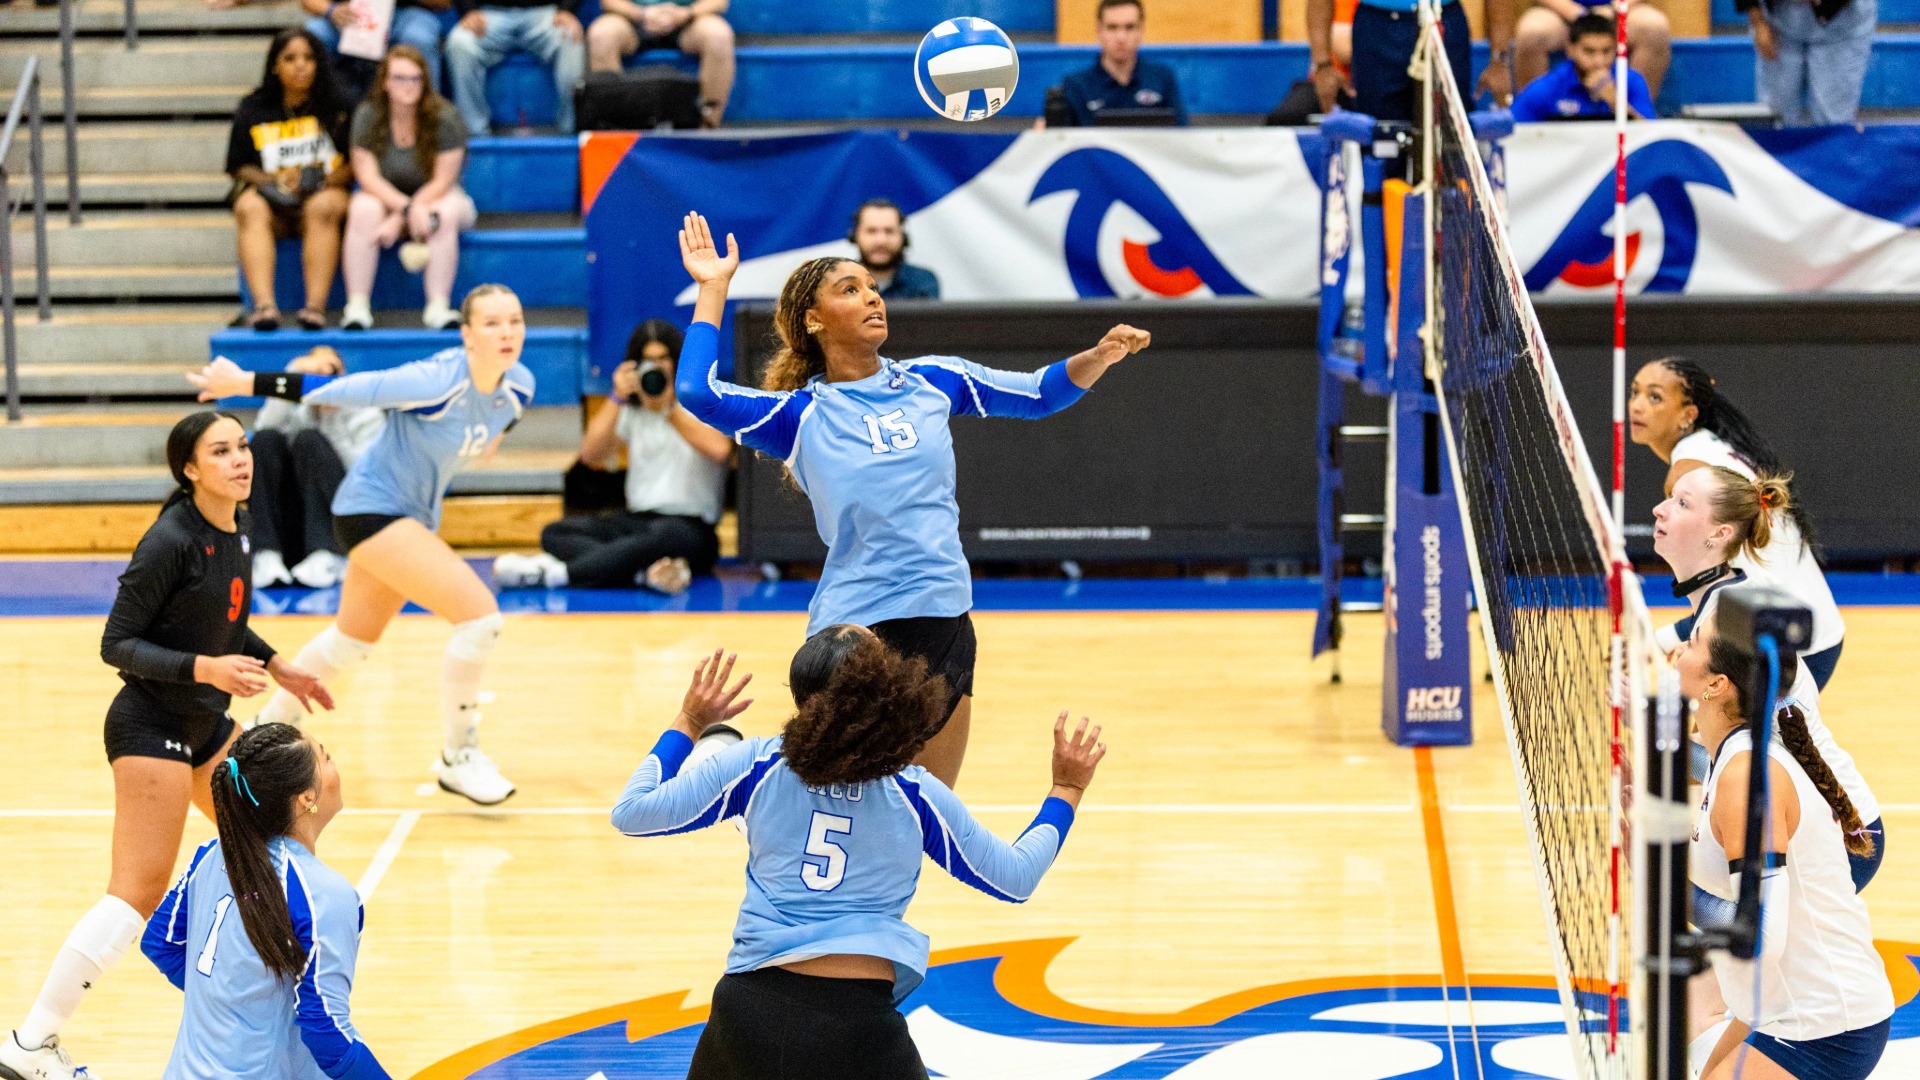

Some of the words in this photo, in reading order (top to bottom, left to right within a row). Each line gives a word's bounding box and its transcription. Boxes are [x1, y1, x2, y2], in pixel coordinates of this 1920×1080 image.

[458, 424, 489, 456] 12
[861, 407, 919, 454] 15
[1421, 525, 1443, 587] sports
[227, 576, 245, 622] 9
[1421, 587, 1444, 660] imports
[1407, 686, 1462, 710] HCU
[799, 809, 853, 892] 5
[196, 893, 235, 977] 1
